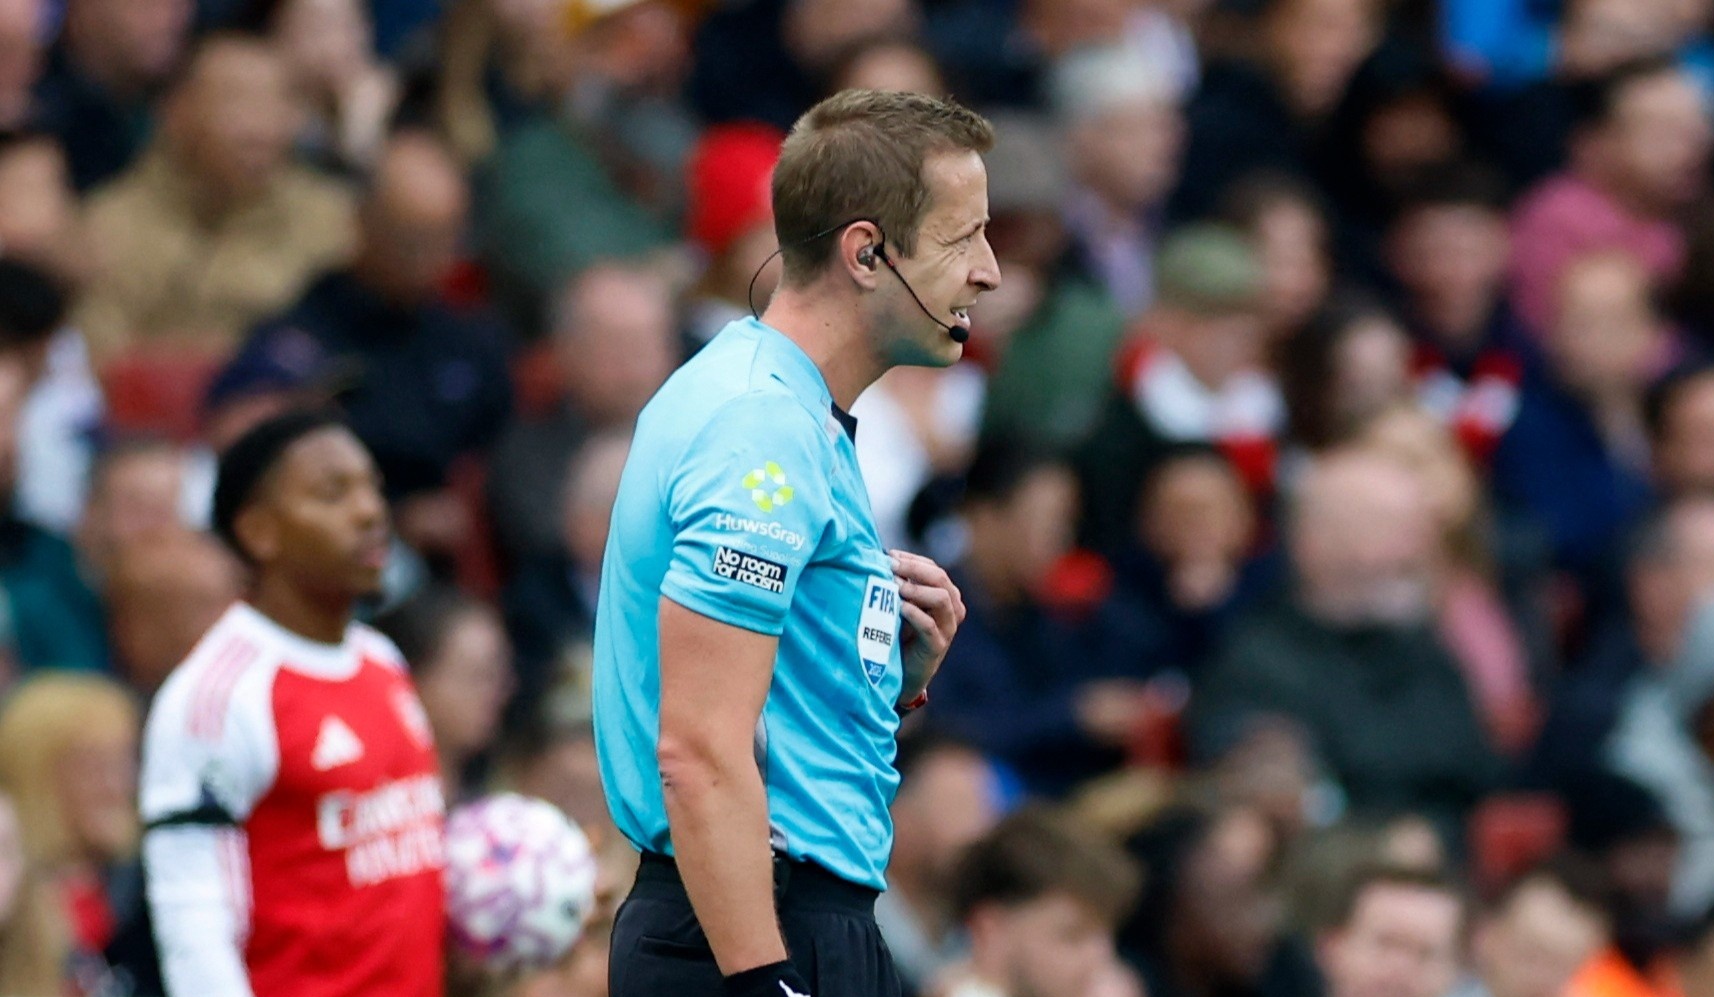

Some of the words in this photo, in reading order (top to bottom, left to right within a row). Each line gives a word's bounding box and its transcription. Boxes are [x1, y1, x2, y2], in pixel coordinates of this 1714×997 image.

[715, 513, 805, 551] HuwsGray
[713, 560, 737, 579] for
[736, 567, 784, 593] racism
[716, 546, 740, 566] No
[741, 556, 781, 579] room
[868, 585, 895, 615] FIFA
[863, 627, 892, 646] REFEREE
